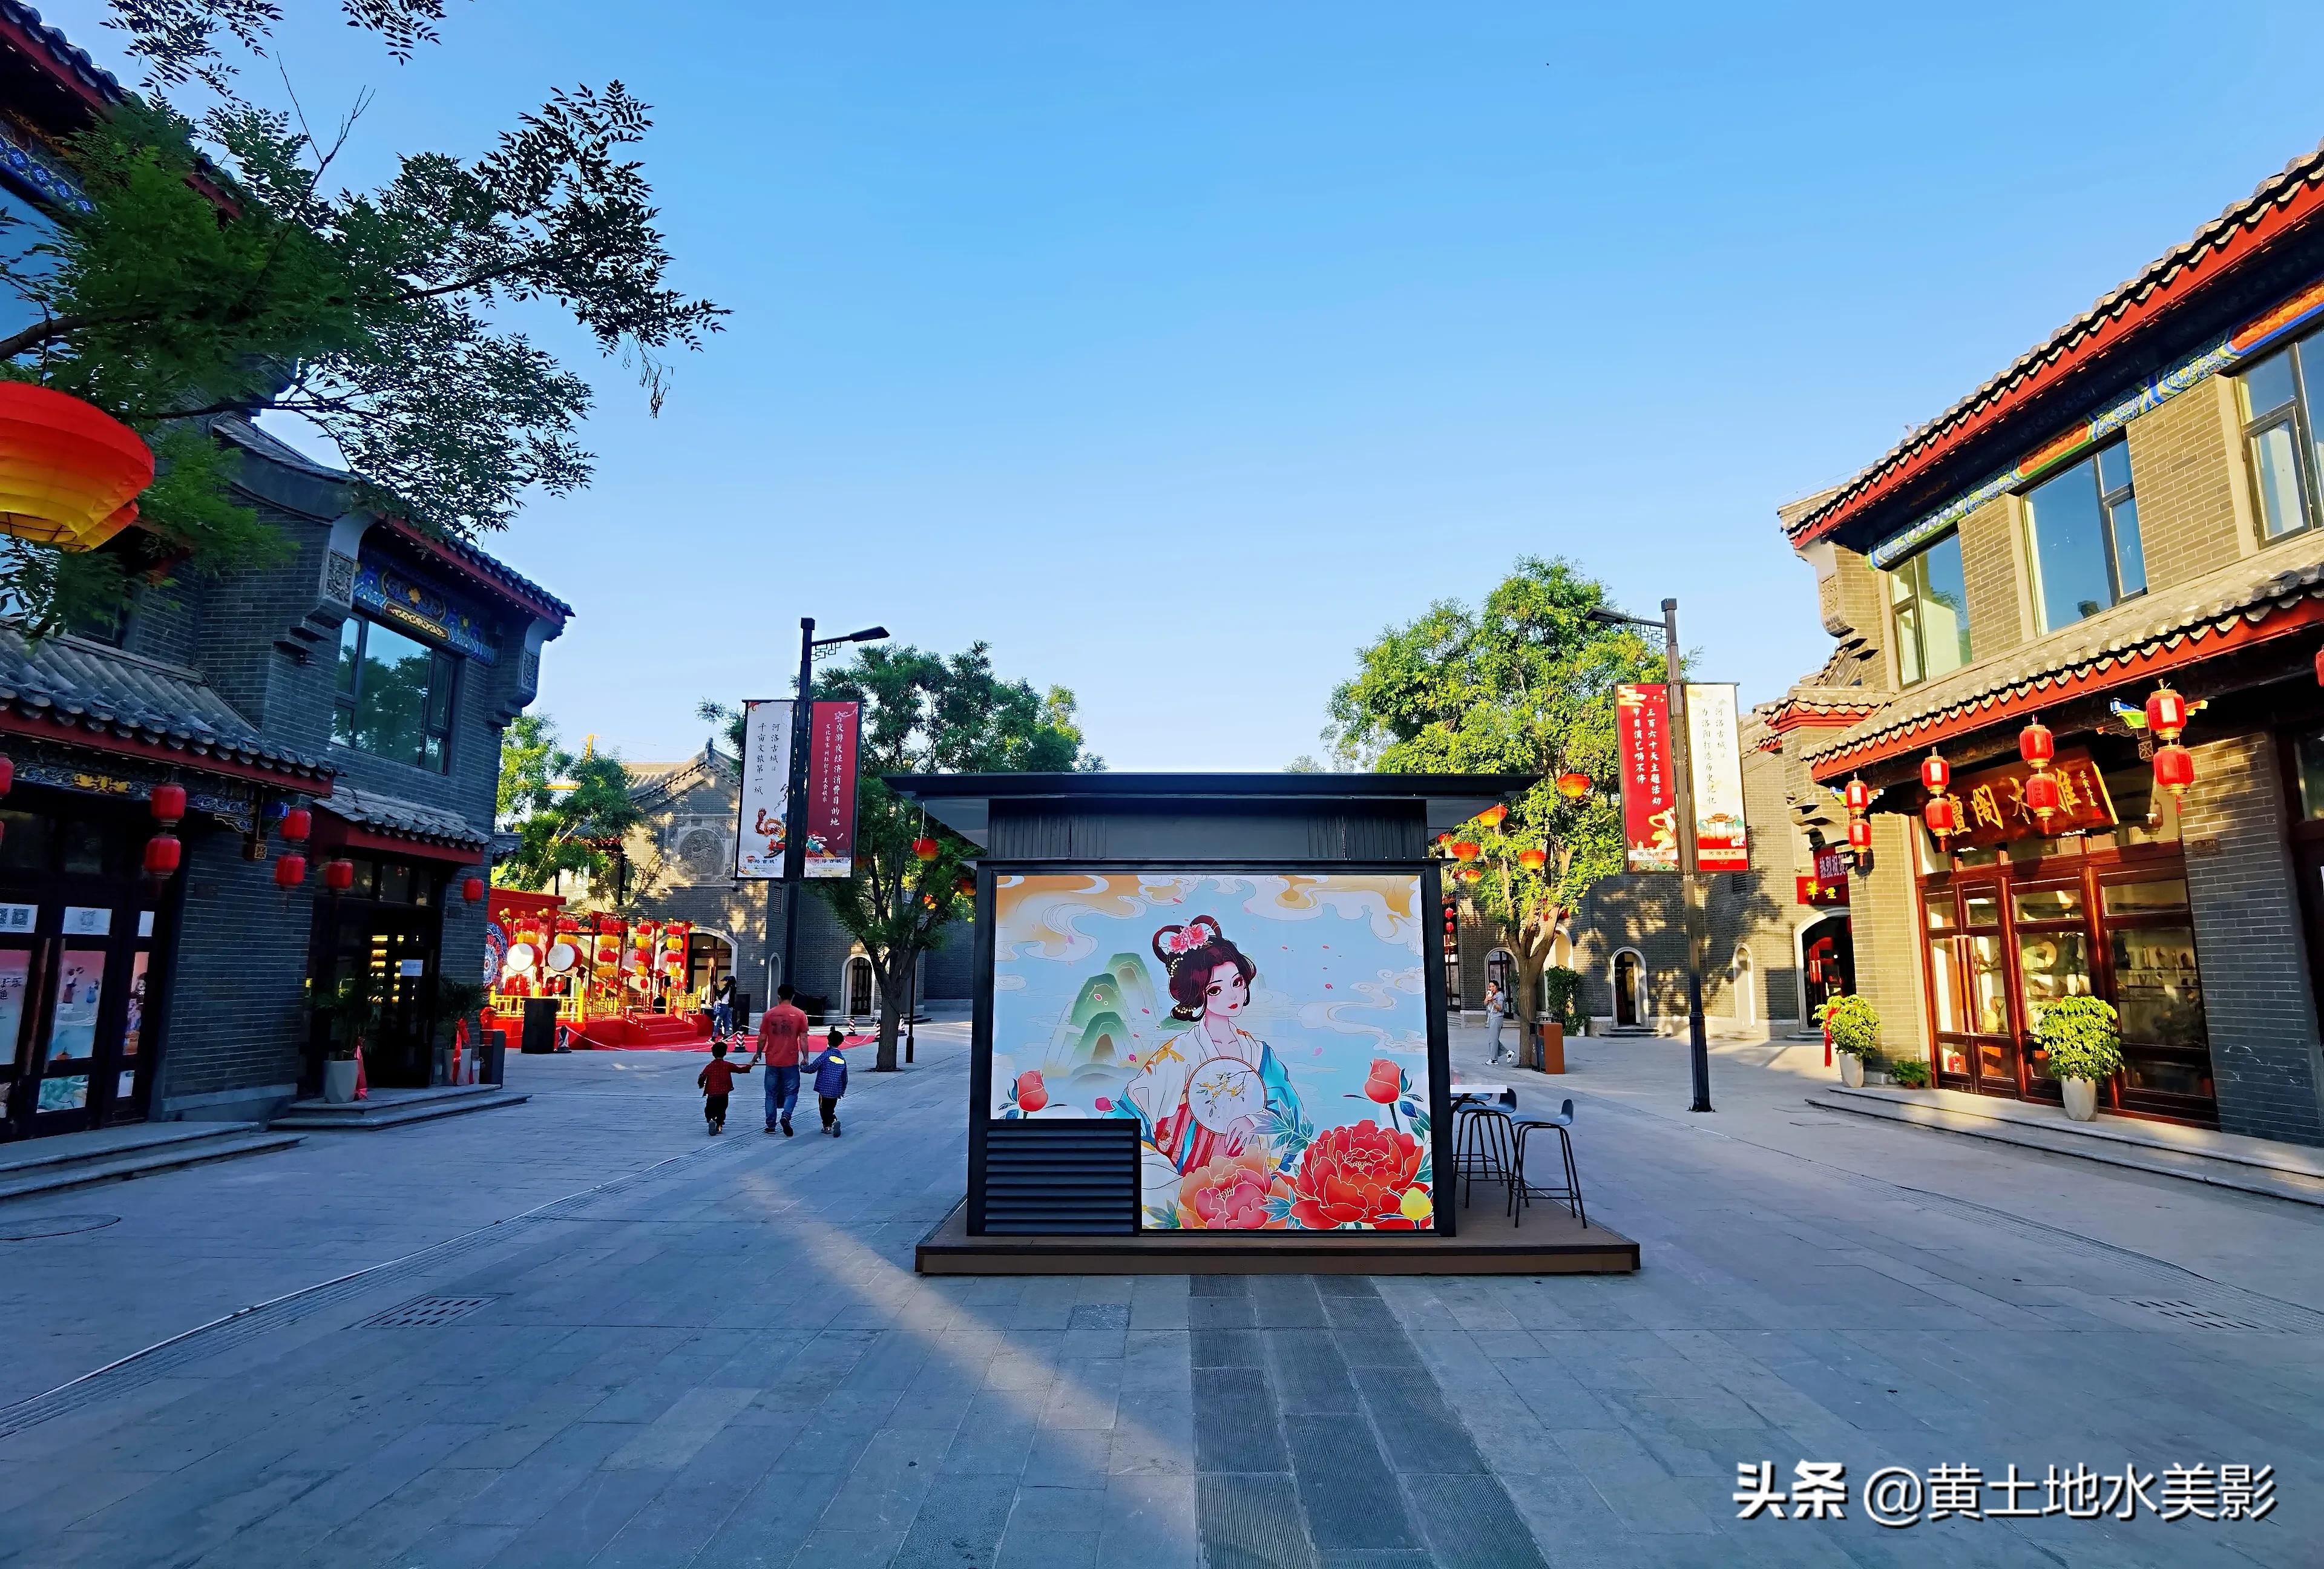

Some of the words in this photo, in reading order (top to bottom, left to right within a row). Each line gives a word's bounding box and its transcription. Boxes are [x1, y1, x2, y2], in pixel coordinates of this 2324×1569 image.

[770, 723, 780, 764] 河洛古城
[1646, 708, 1663, 806] 三百六十天主题活动
